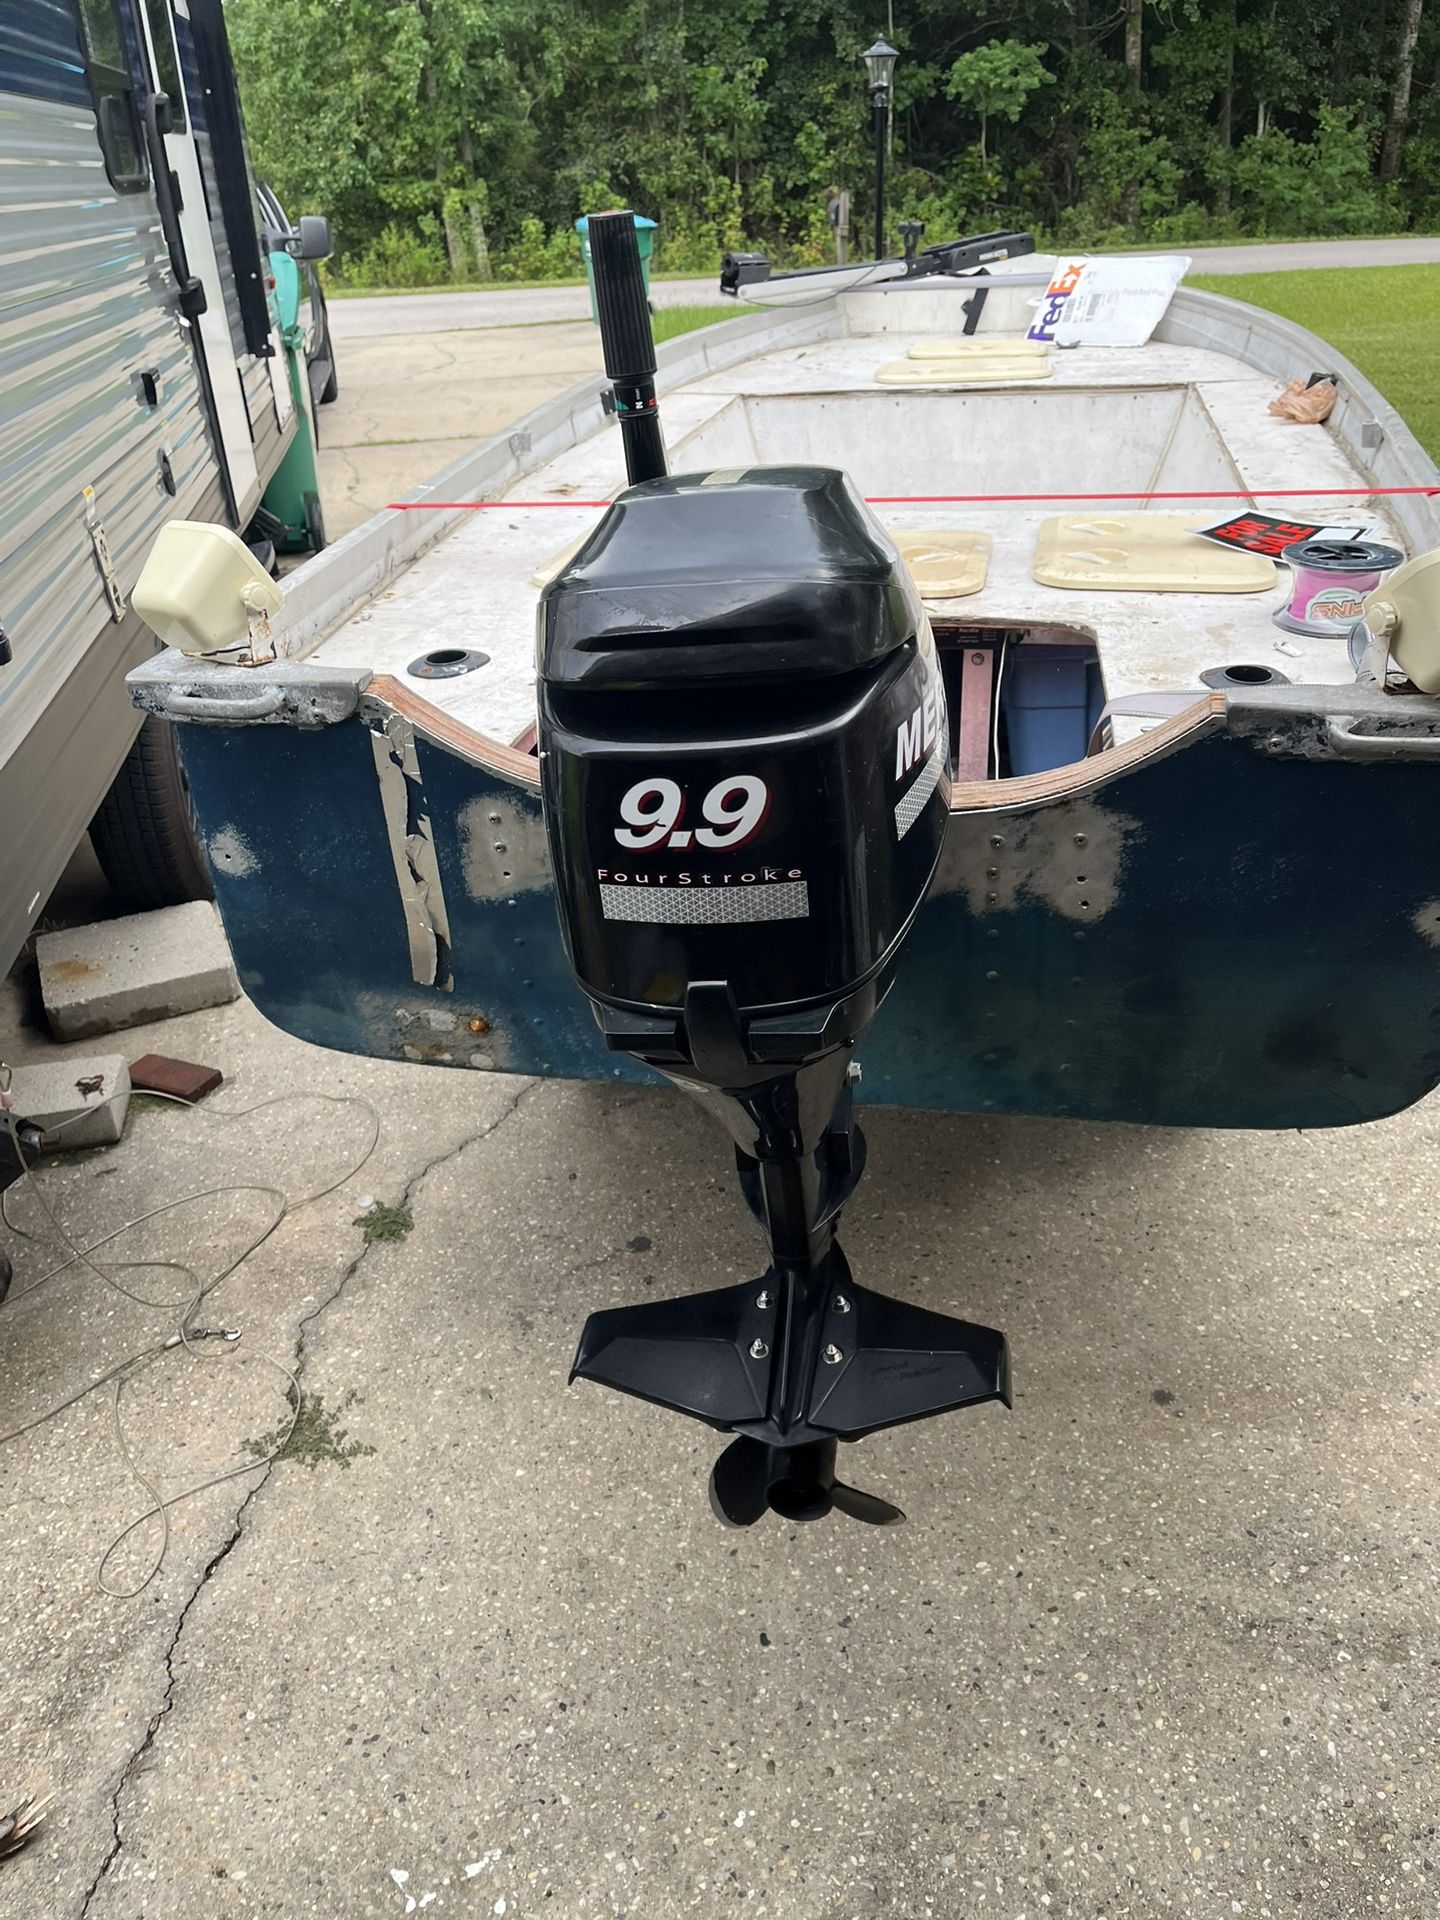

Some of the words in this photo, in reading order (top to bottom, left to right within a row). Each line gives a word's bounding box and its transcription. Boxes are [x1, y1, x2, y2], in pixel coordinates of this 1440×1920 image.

[1028, 263, 1086, 342] FedEx
[635, 401, 644, 409] N
[1214, 519, 1271, 541] FOR
[1244, 523, 1316, 555] SALE
[614, 775, 770, 851] 9.9
[597, 868, 802, 885] FourStroke
